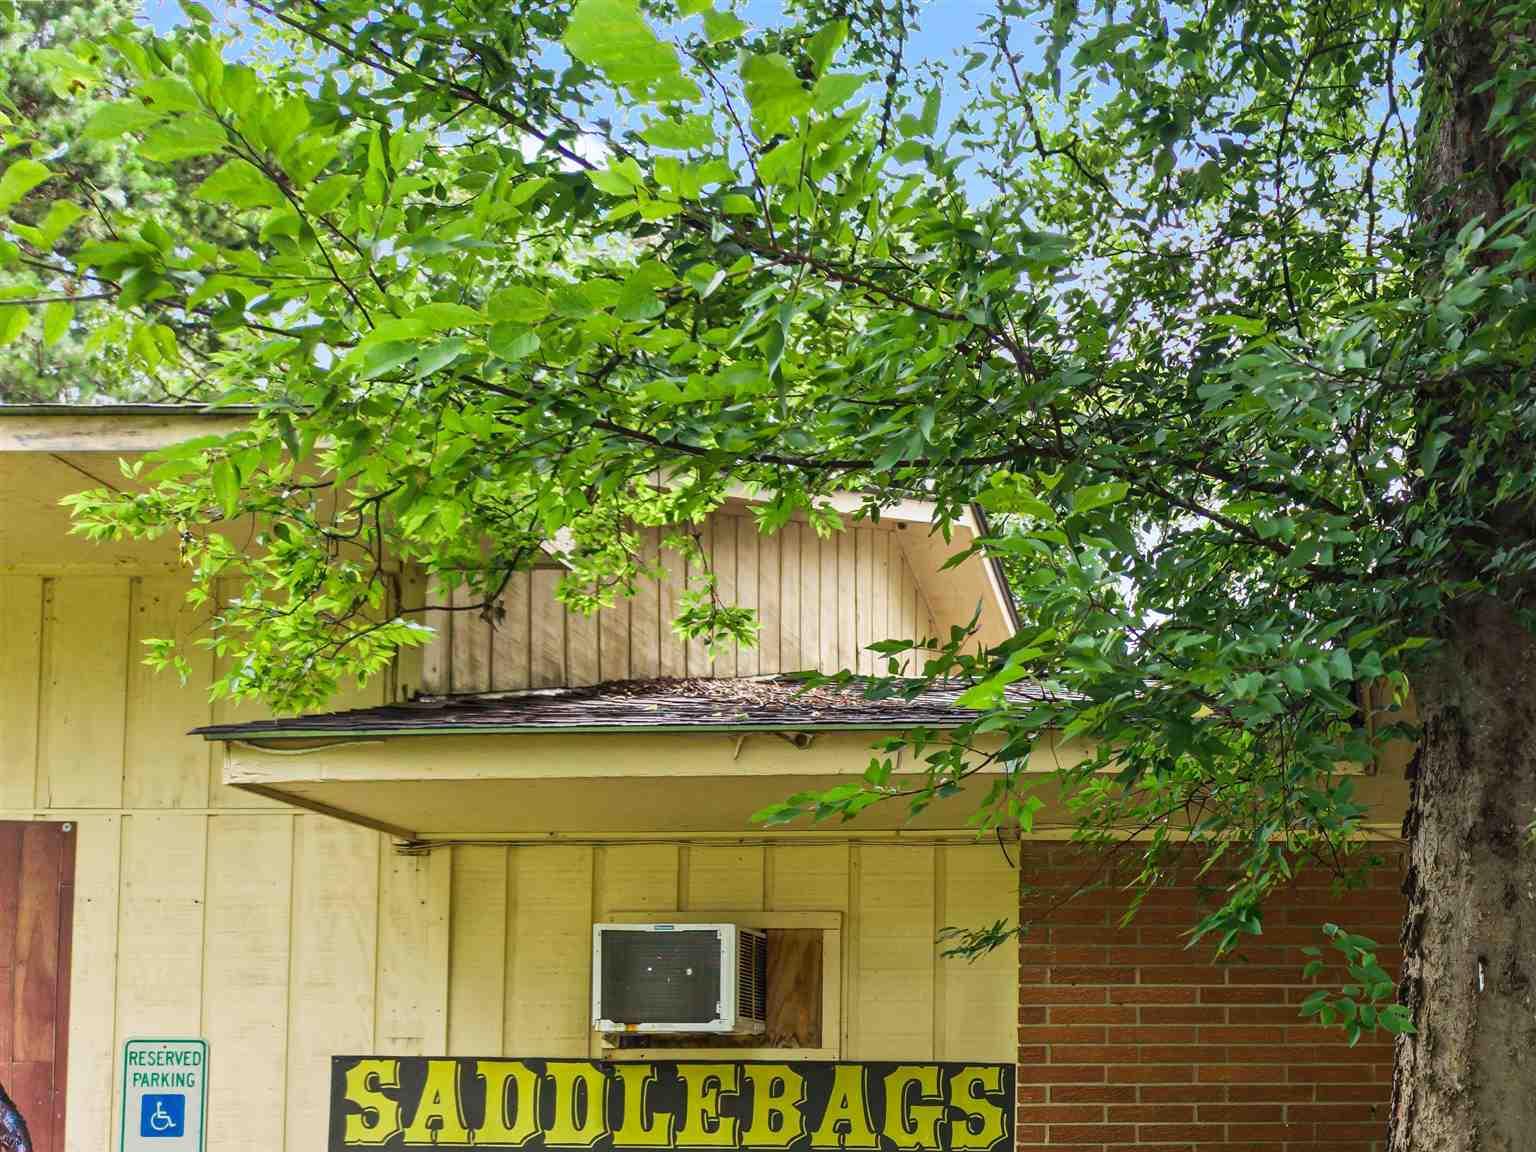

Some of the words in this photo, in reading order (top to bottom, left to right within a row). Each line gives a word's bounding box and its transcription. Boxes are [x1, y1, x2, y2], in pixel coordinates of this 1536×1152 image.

[129, 1051, 200, 1065] RESERVED
[133, 1073, 194, 1087] PARKING
[345, 1059, 1008, 1152] SADDLEBAGS
